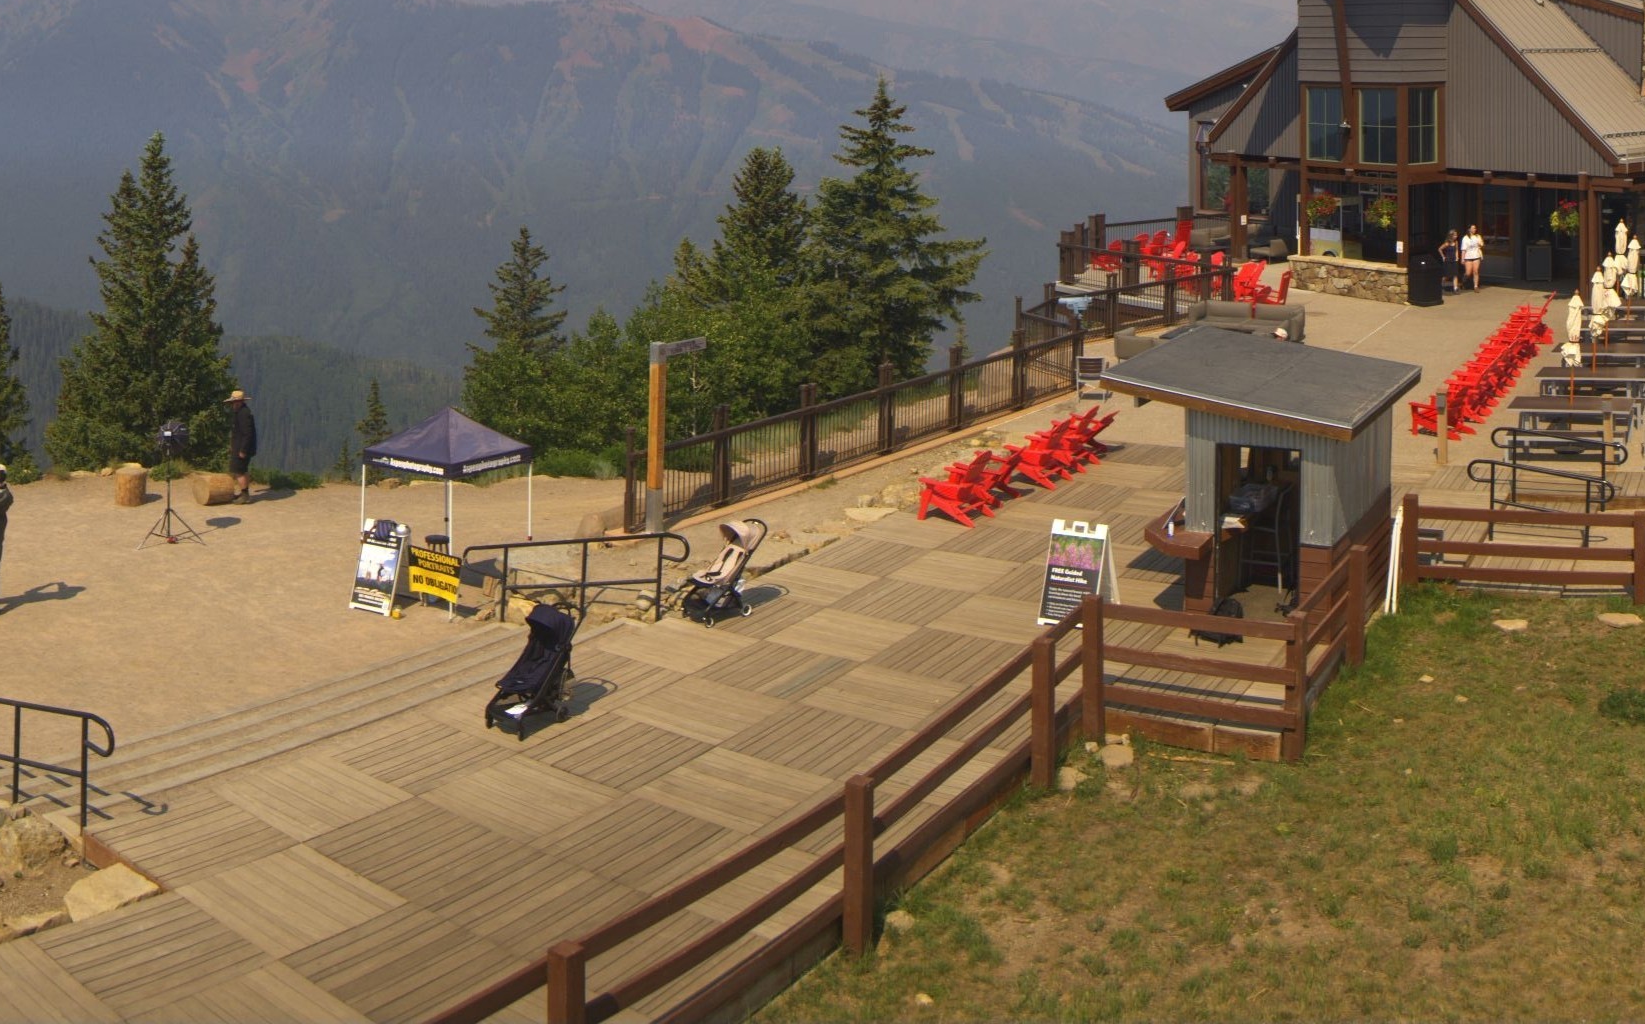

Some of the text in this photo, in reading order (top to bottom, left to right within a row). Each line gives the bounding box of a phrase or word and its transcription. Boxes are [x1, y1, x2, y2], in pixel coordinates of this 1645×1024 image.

[410, 546, 460, 567] PROFESSIONAL
[417, 558, 455, 575] PORTRAITS
[1065, 568, 1083, 576] Guided
[412, 574, 424, 584] NO
